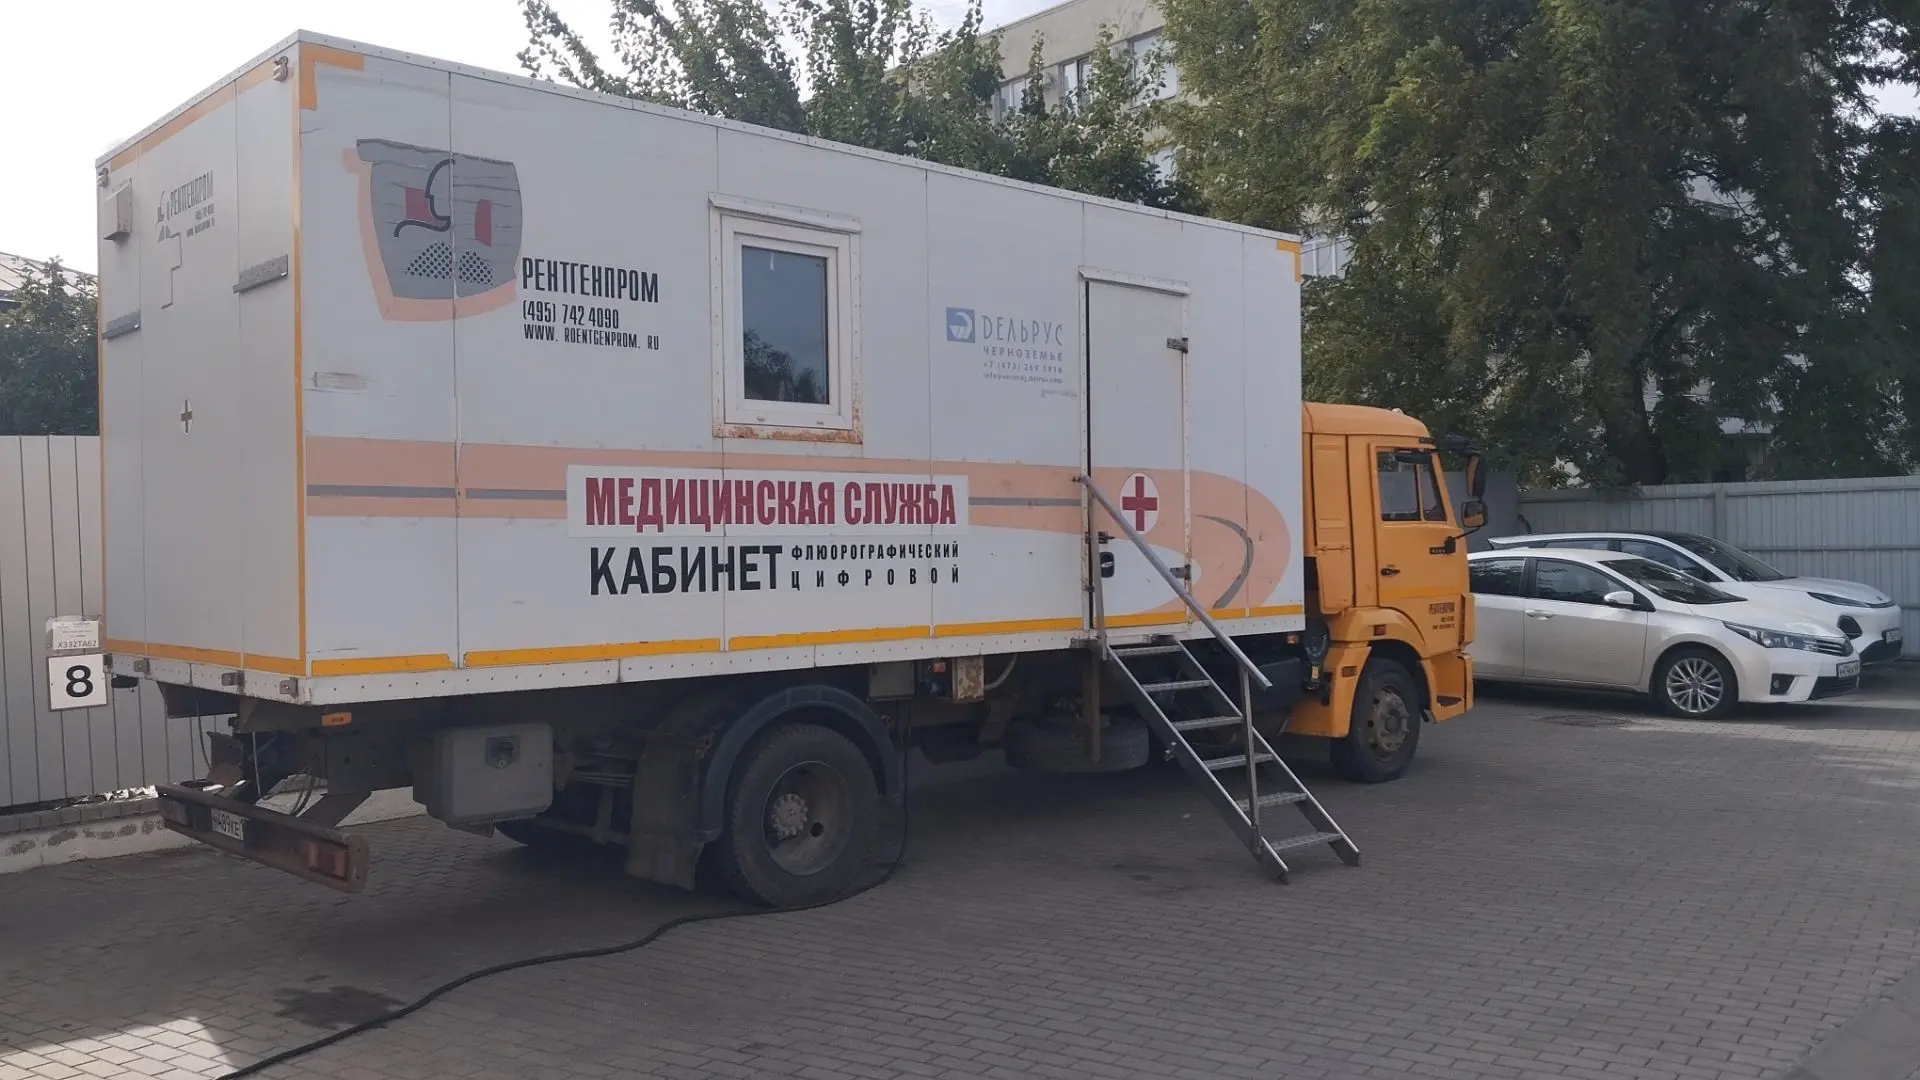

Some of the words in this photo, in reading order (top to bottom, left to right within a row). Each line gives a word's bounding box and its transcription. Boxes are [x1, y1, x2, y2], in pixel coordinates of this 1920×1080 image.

[522, 257, 659, 303] РЕНТГЕНПРОМ
[523, 300, 556, 323] (495)
[562, 304, 585, 326] 742
[588, 307, 619, 329] 4090
[524, 323, 558, 342] WWW.
[647, 335, 659, 350] RU
[983, 346, 1063, 361] ЧЕРНОЗЕМЬЕ
[585, 477, 836, 533] МЕДИЦИНСКАЯ
[843, 481, 957, 526] СЛУЖБА
[791, 540, 960, 561] ФЛЮОРОГРАФИЧЕСКИЙ
[590, 545, 783, 596] КАБИНЕТ
[791, 564, 960, 591] ЦИФРОВОЙ
[66, 664, 93, 698] 8
